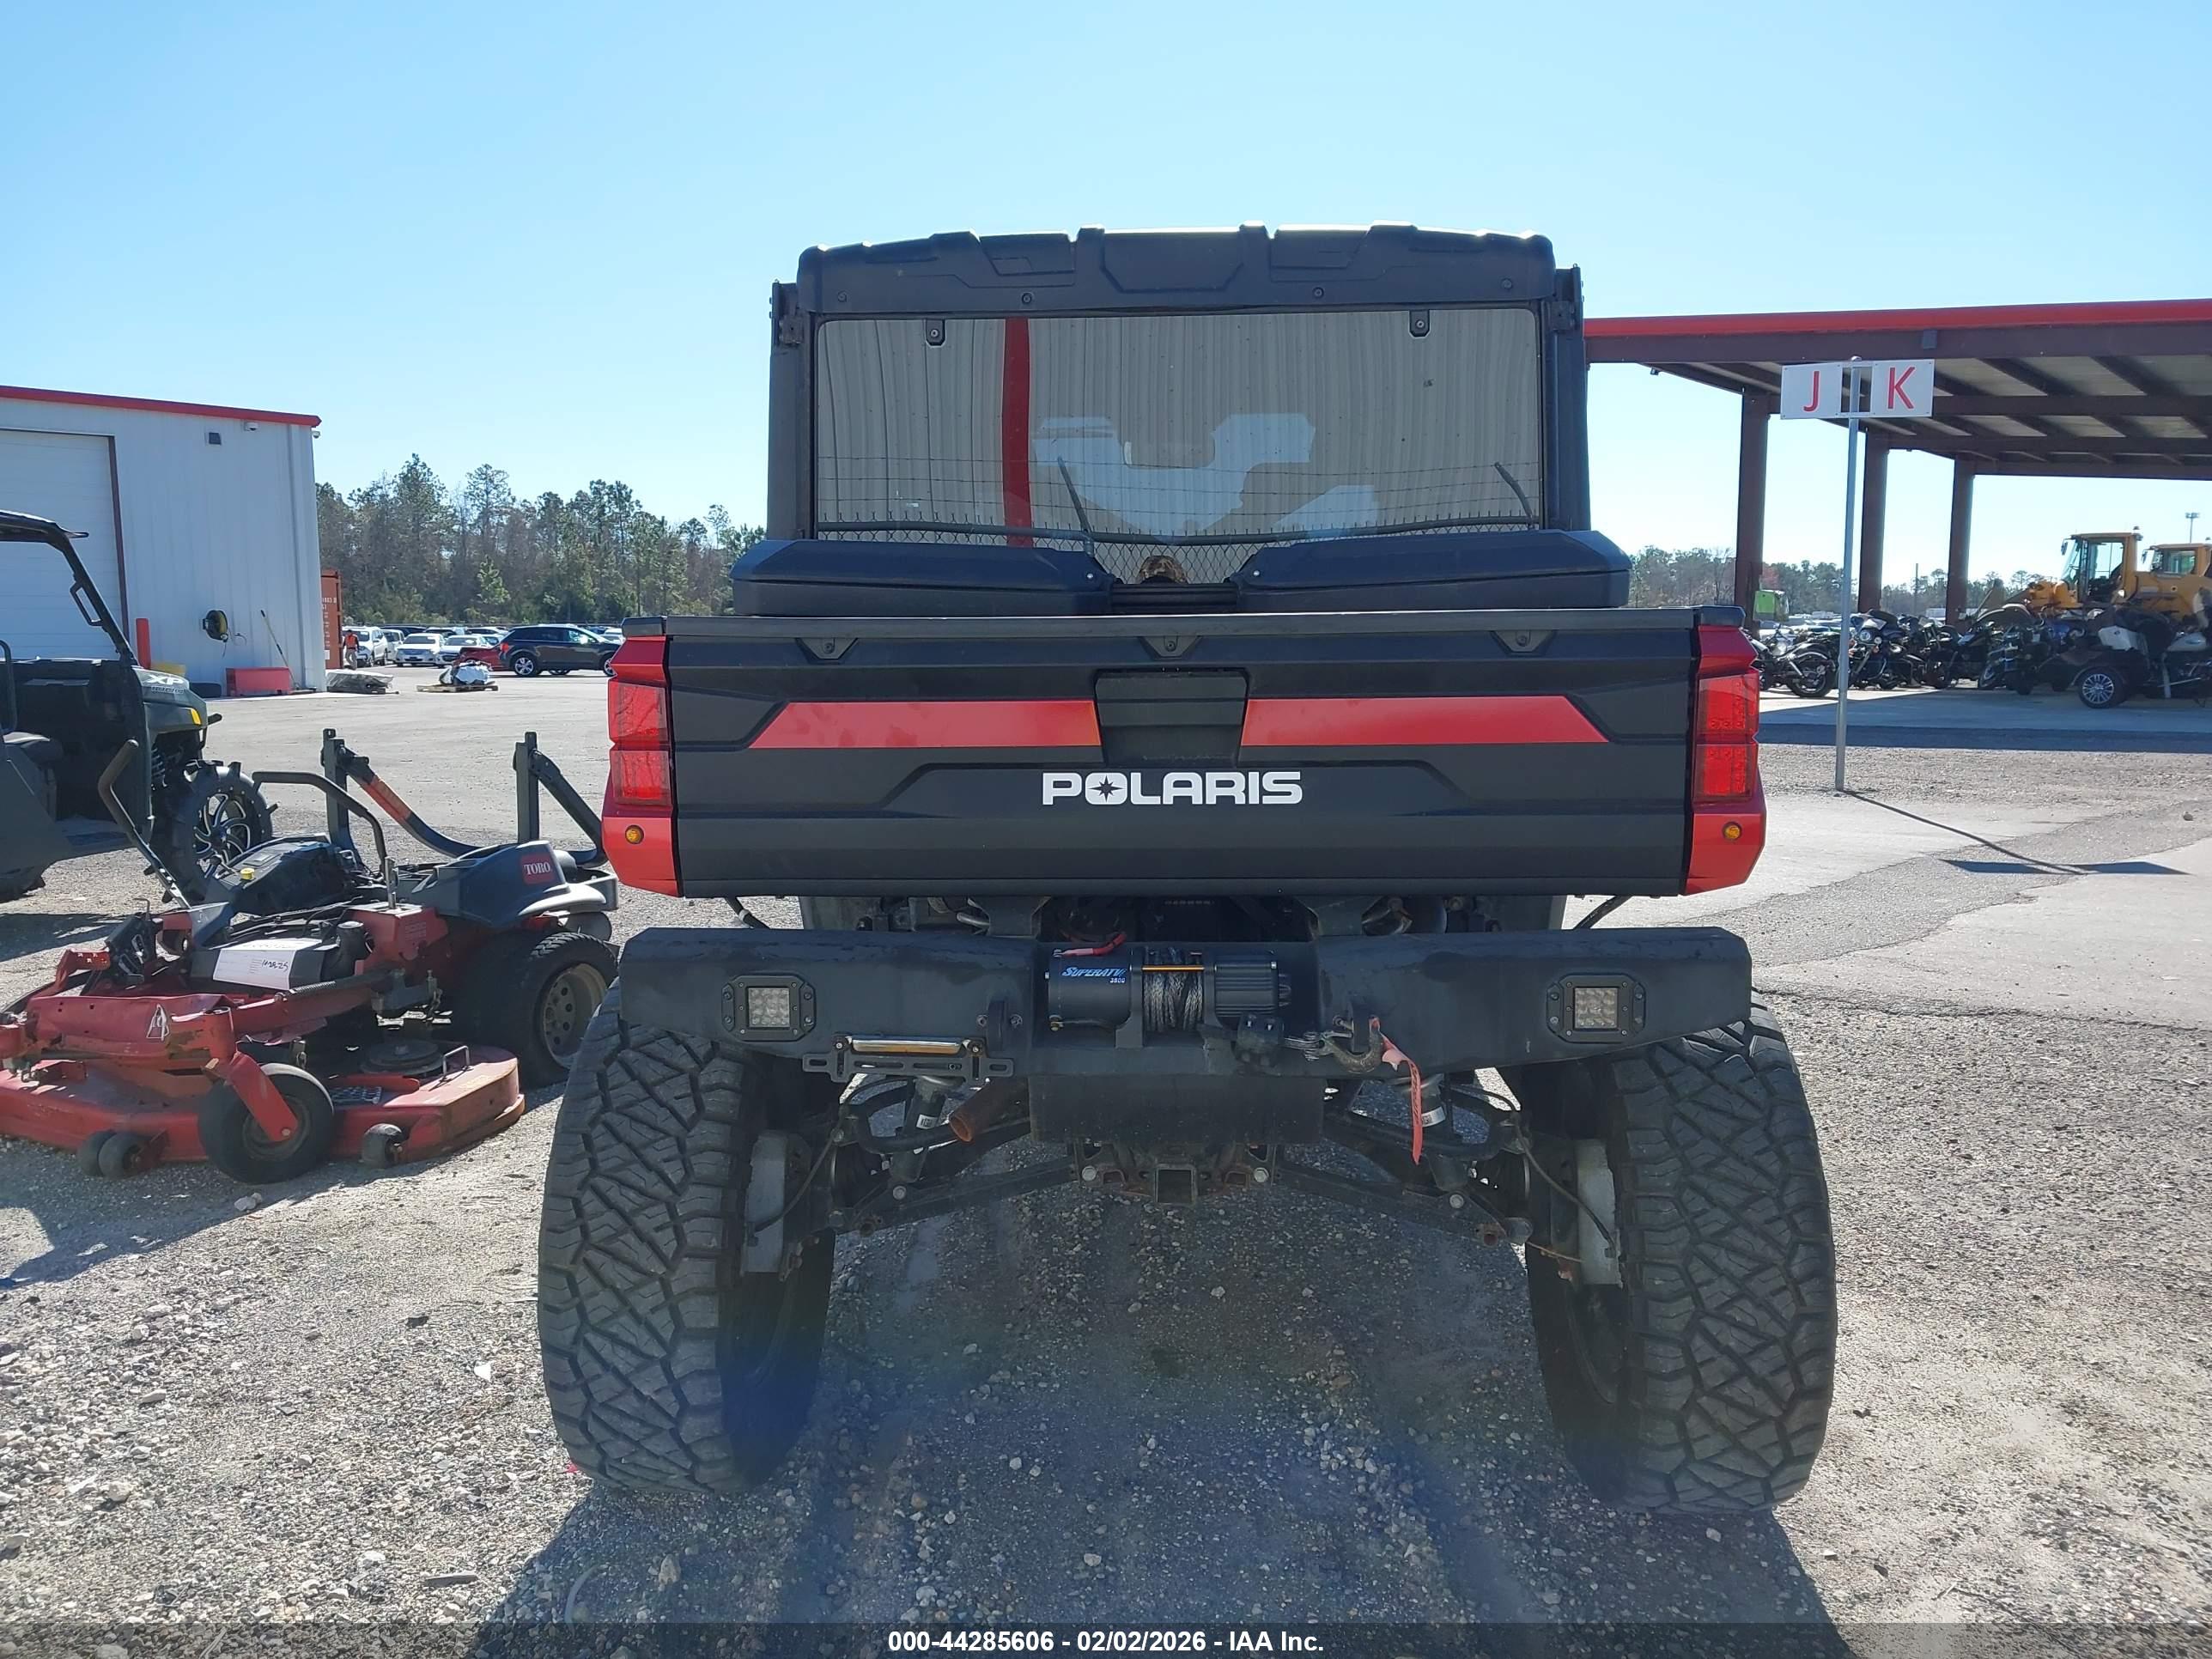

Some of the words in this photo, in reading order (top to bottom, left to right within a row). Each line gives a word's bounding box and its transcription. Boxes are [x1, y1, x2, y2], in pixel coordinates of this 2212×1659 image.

[1803, 370, 1820, 412] J
[1887, 366, 1916, 410] K
[147, 674, 184, 685] XP
[1042, 771, 1304, 805] POLARIS
[524, 861, 550, 875] TORO
